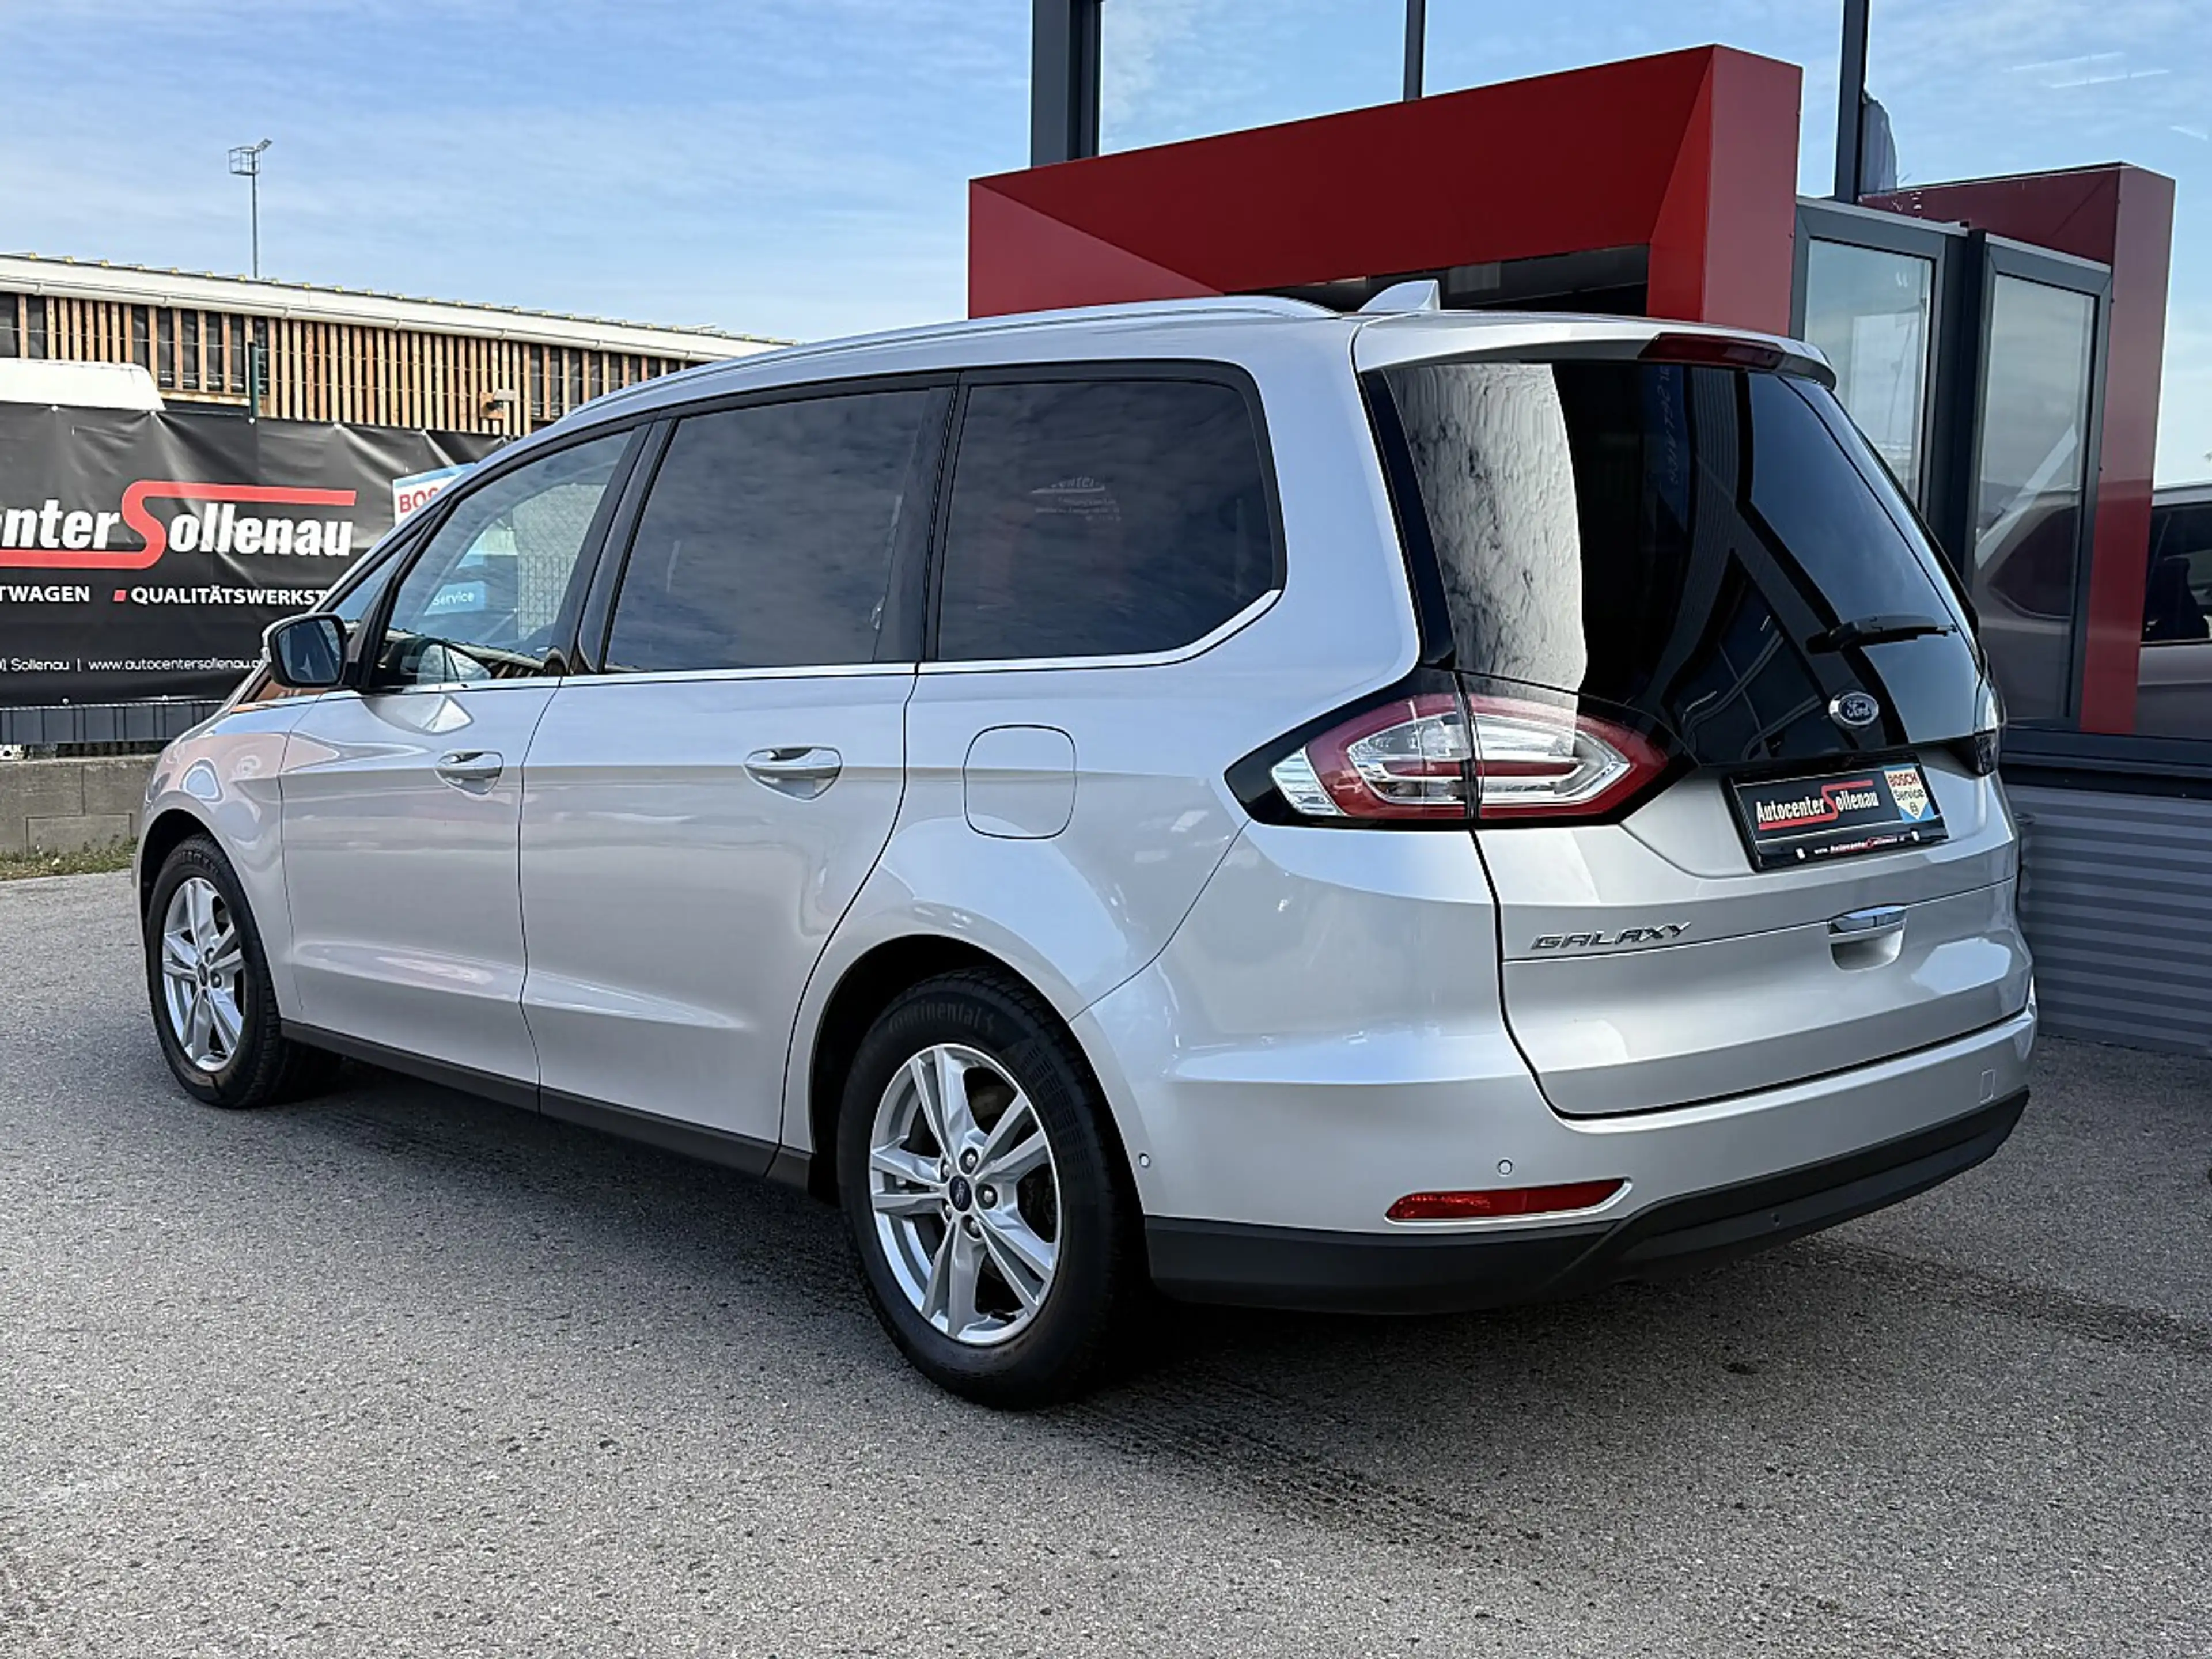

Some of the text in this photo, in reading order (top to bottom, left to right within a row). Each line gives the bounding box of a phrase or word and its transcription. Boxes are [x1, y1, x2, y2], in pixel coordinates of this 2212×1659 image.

[10, 658, 70, 672] Sollenau
[1893, 788, 1925, 801] Service
[1531, 921, 1691, 950] GALAXY
